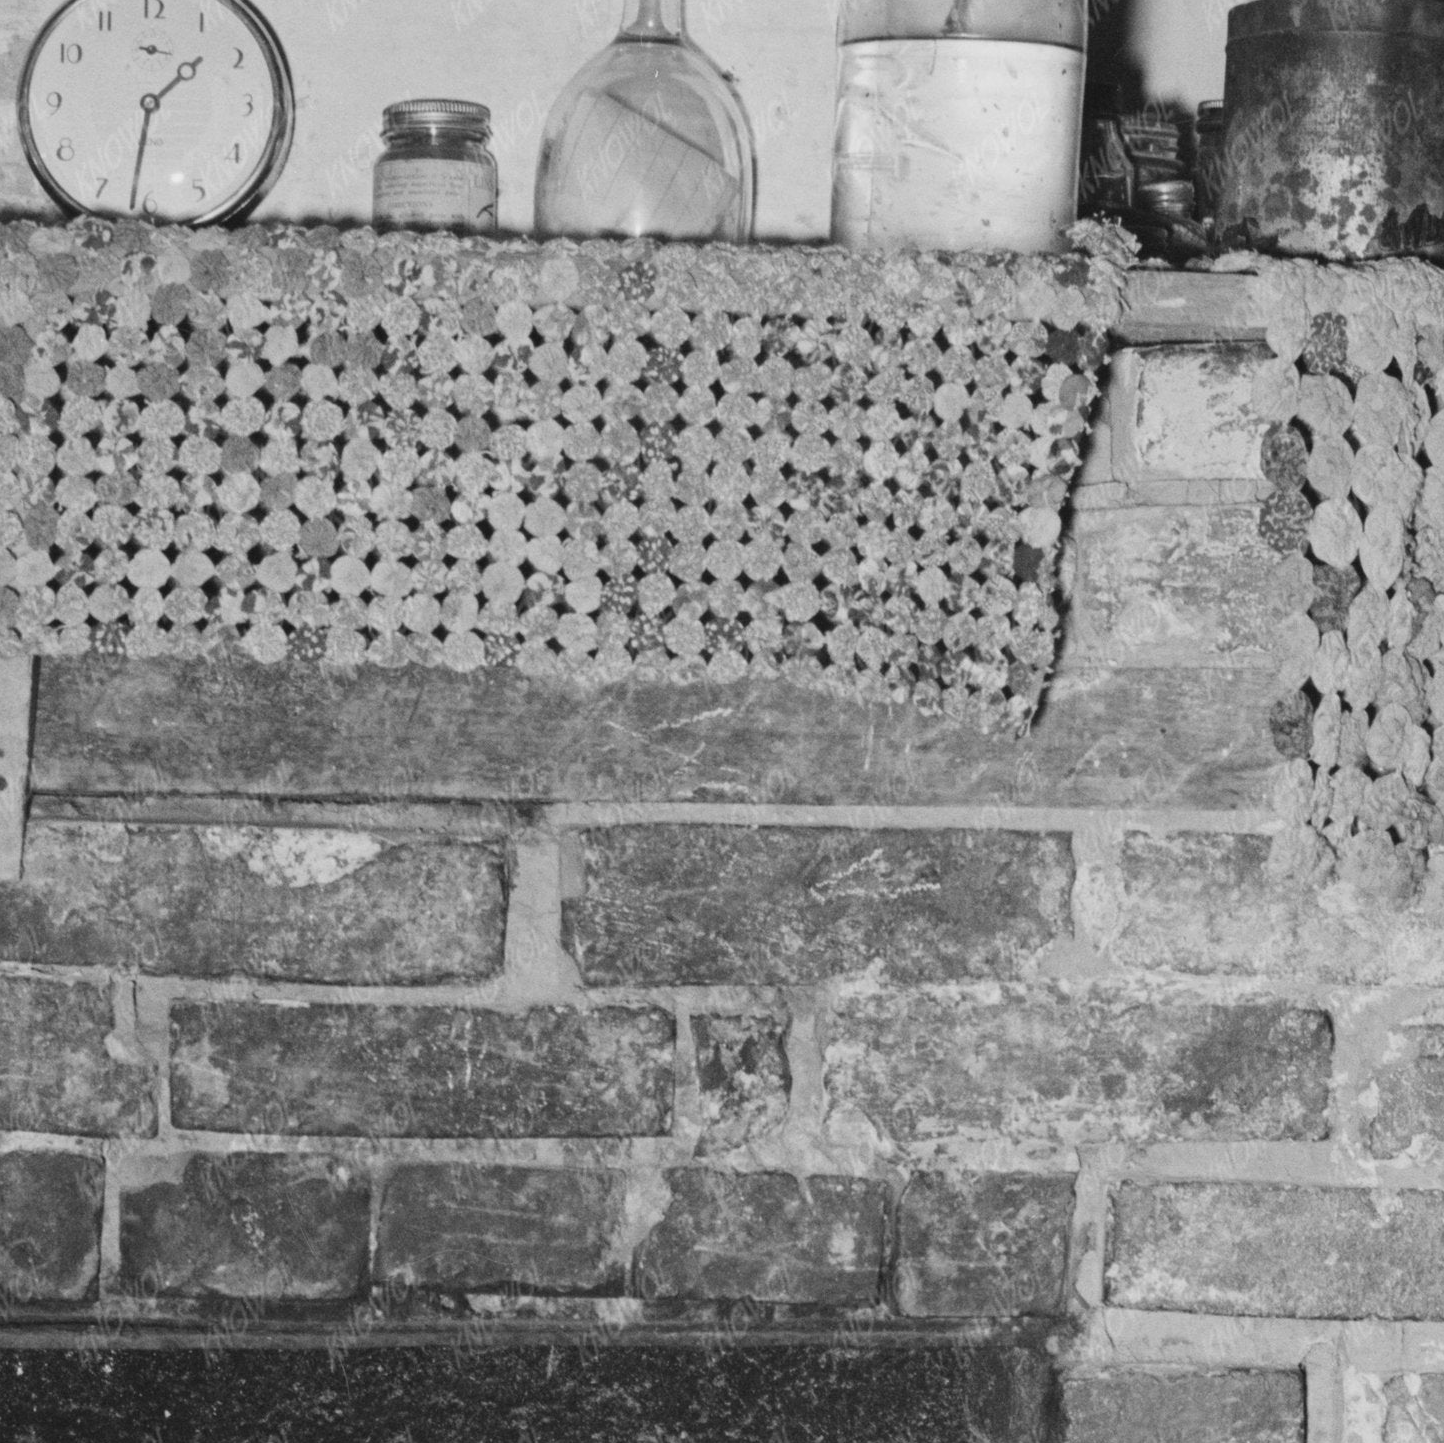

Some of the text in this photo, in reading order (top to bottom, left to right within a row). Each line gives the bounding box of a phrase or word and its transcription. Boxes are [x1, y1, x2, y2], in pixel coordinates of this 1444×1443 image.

[98, 10, 112, 32] 11
[198, 11, 204, 33] 1
[60, 42, 83, 64] 10
[232, 46, 244, 69] 2
[45, 91, 63, 116] 9
[242, 93, 254, 117] 3
[55, 137, 75, 162] 8
[225, 142, 240, 164] 4
[96, 177, 109, 199] 7
[191, 178, 206, 202] 5
[142, 190, 158, 214] 6
